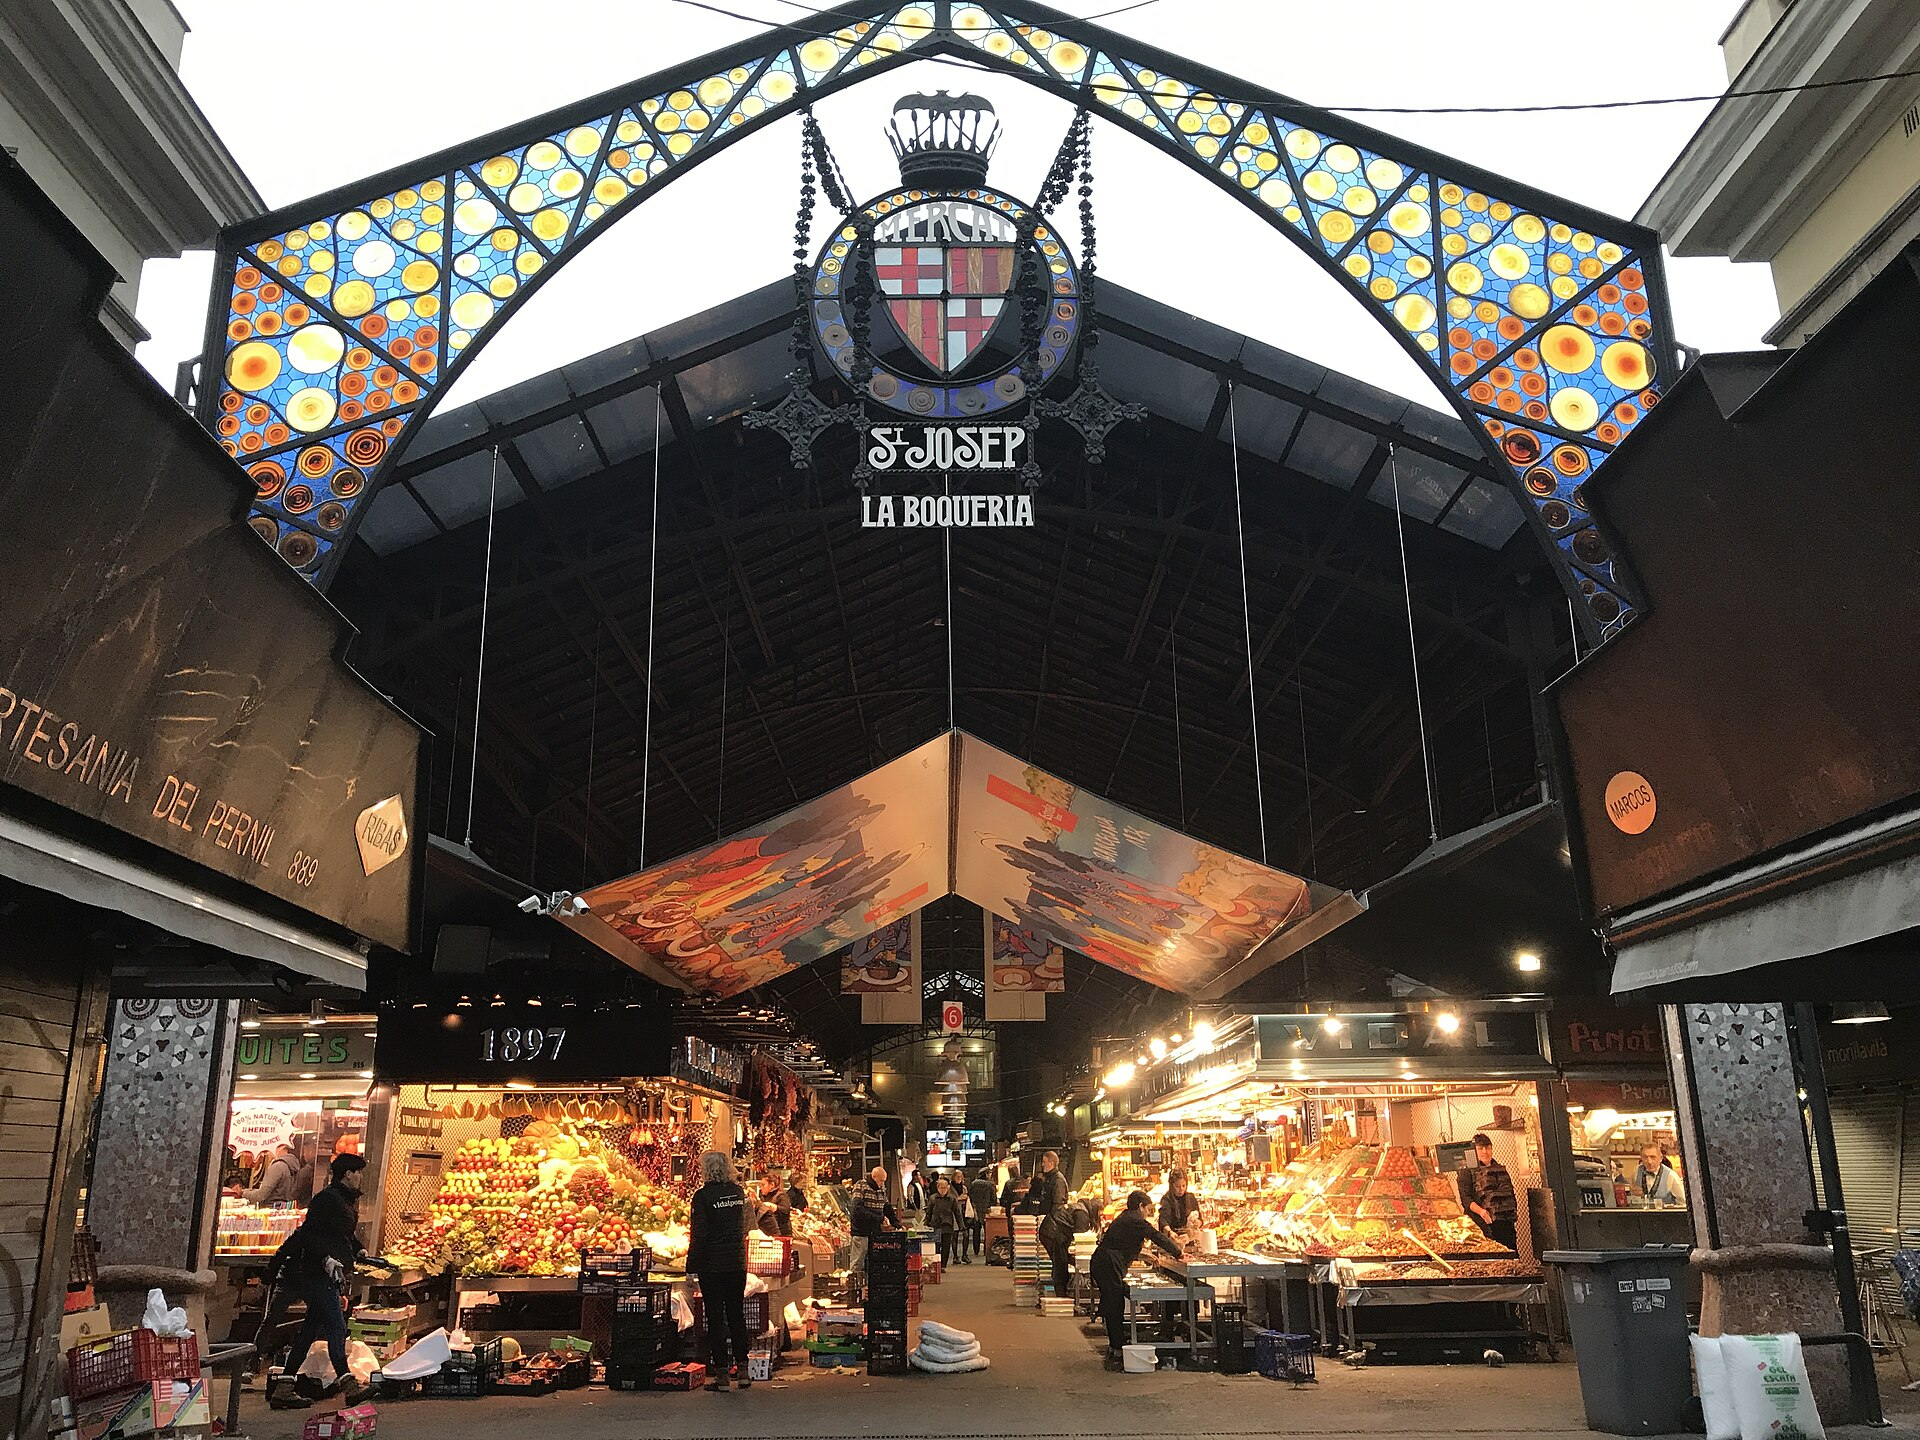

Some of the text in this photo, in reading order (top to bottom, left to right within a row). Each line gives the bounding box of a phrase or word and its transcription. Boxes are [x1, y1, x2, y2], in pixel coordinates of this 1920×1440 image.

[880, 202, 1012, 243] MERCAT
[904, 426, 1026, 470] JOSEP
[862, 495, 1034, 527] LA BOQUERIA
[1610, 784, 1651, 821] MARCOS
[152, 784, 201, 832] DEL
[202, 800, 276, 868] PERNIL
[287, 850, 319, 887] 889
[361, 812, 401, 858] RIBAS
[949, 1010, 959, 1025] 6
[239, 1036, 348, 1065] UITES
[478, 1027, 566, 1062] 1897
[232, 1114, 252, 1127] 100%
[253, 1113, 286, 1128] NATURAL
[234, 1134, 281, 1147] FRUITS JUICE
[1584, 1192, 1603, 1205] RB
